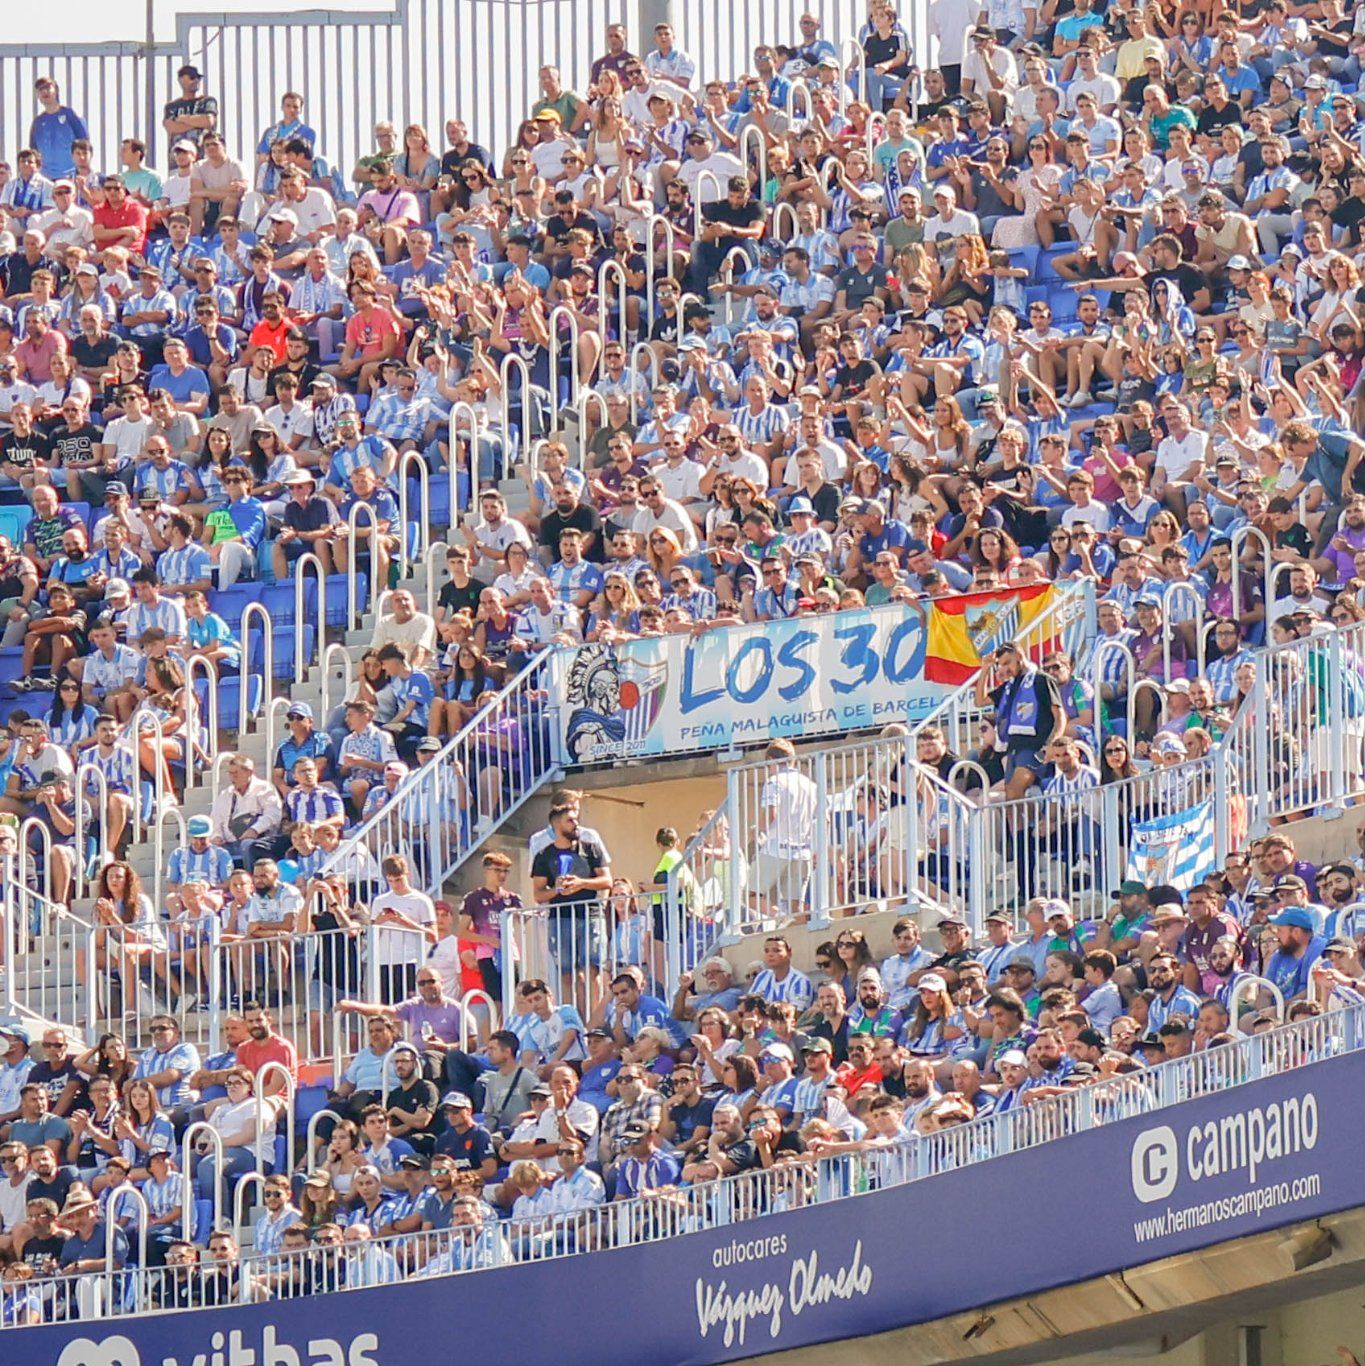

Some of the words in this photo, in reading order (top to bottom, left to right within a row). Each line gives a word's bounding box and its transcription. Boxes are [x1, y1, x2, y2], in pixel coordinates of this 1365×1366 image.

[679, 631, 820, 715] LOS
[680, 720, 726, 740] PEÑA
[731, 707, 838, 738] MALAGUISTA
[843, 703, 868, 719] DE
[589, 742, 623, 757] SINCE
[1187, 1092, 1320, 1184] campano
[1133, 1173, 1320, 1244] www.hermanoscampano.com
[713, 1233, 787, 1268] autocares
